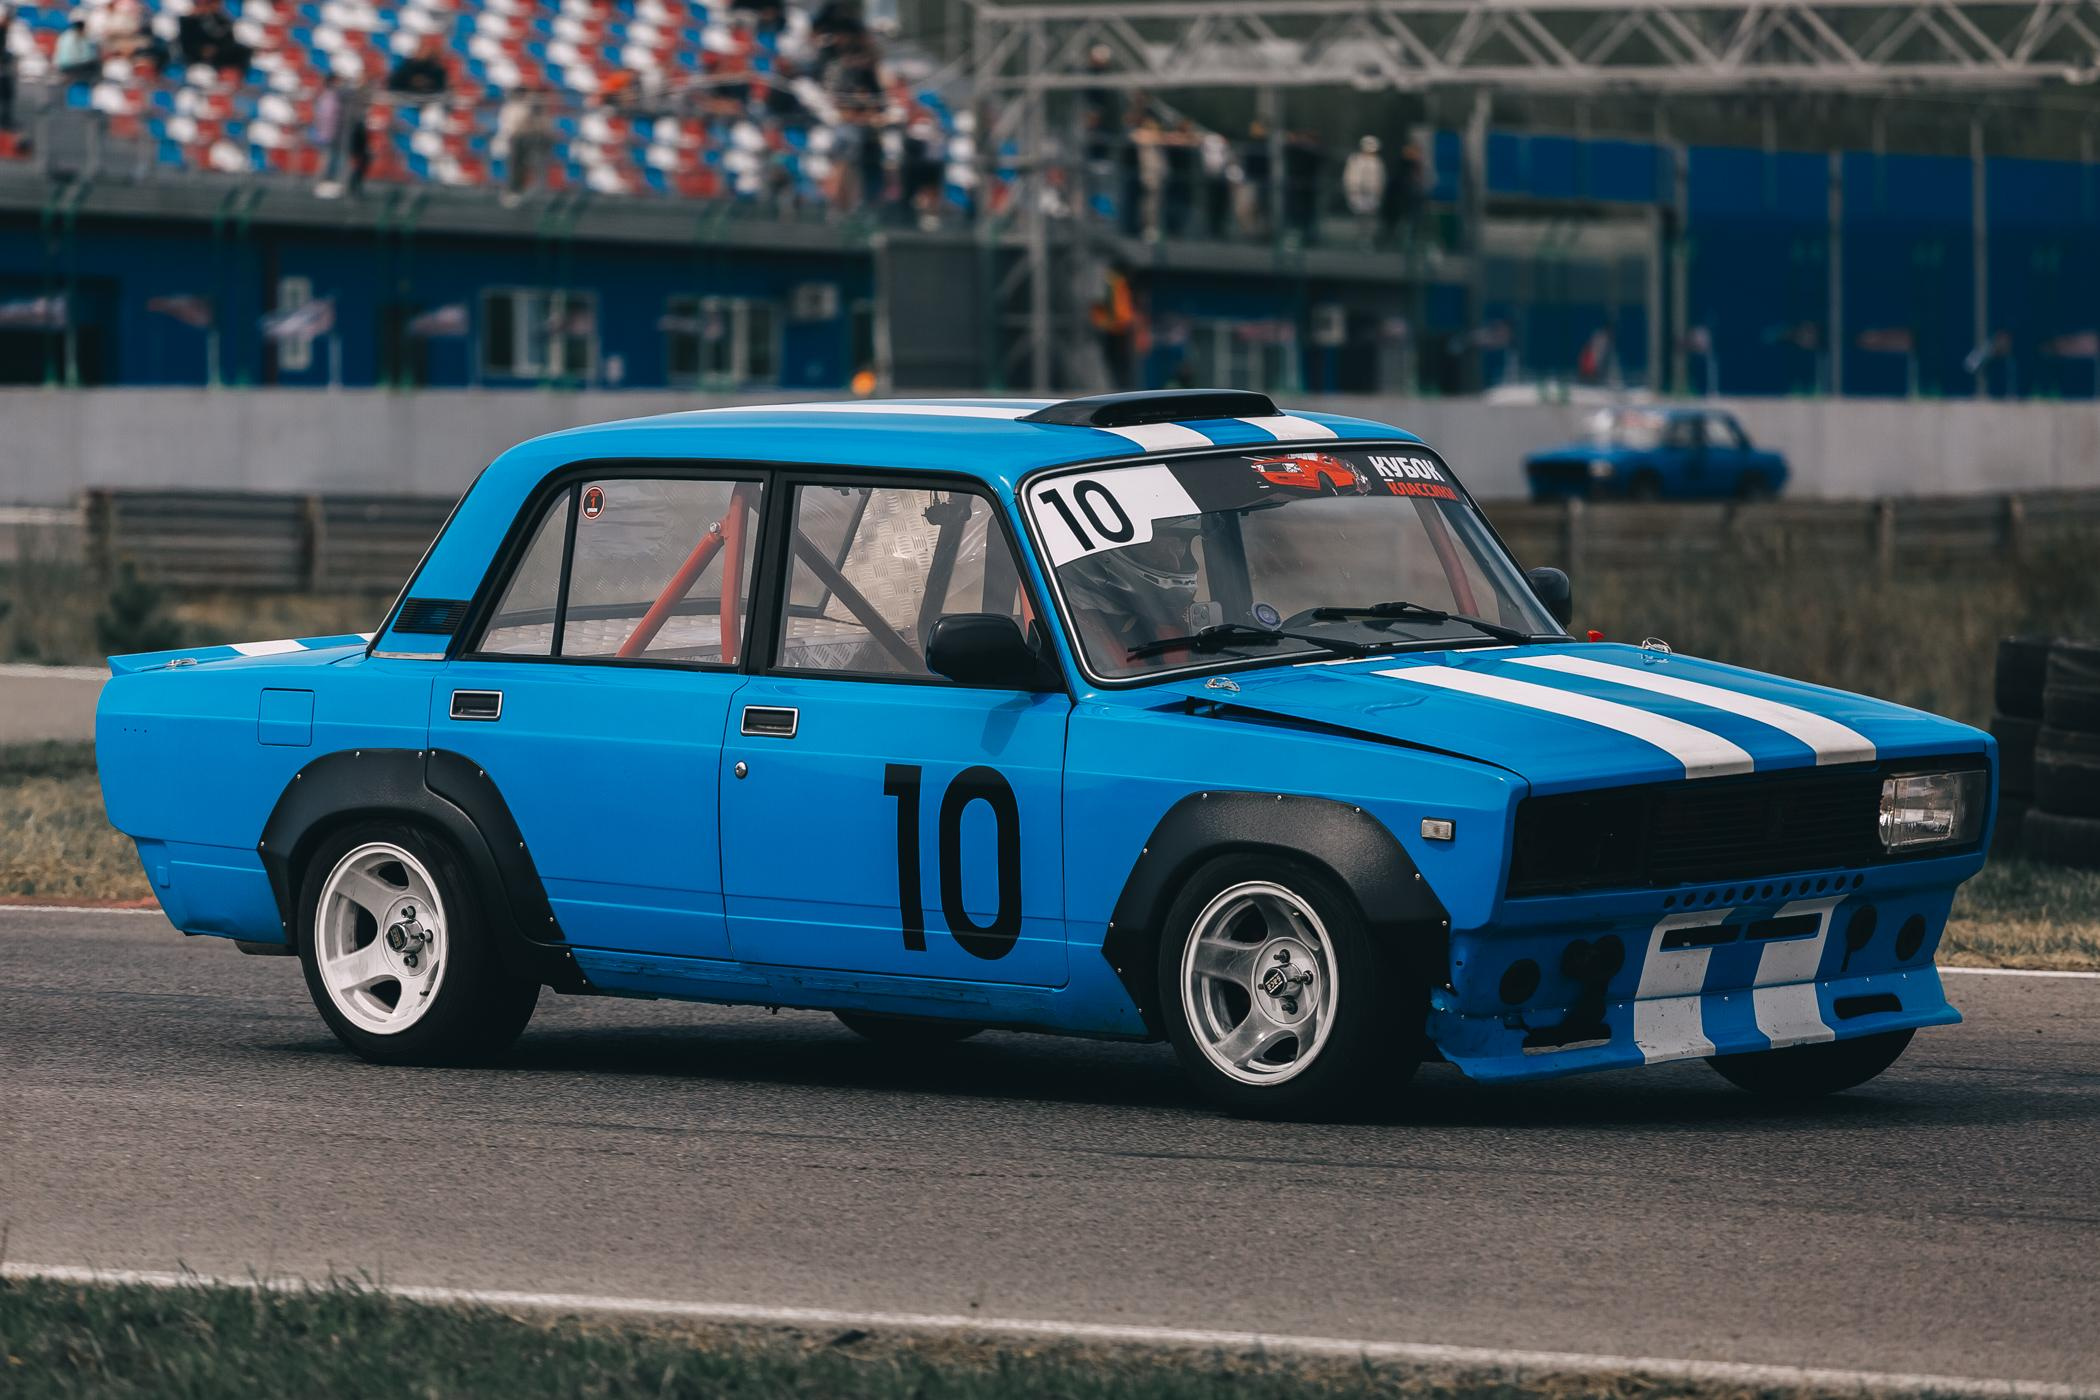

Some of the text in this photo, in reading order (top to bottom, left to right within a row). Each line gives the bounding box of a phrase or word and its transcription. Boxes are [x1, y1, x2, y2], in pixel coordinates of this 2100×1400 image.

[1368, 456, 1445, 482] КУБОК
[1038, 480, 1135, 551] 10
[883, 763, 1022, 960] 10
